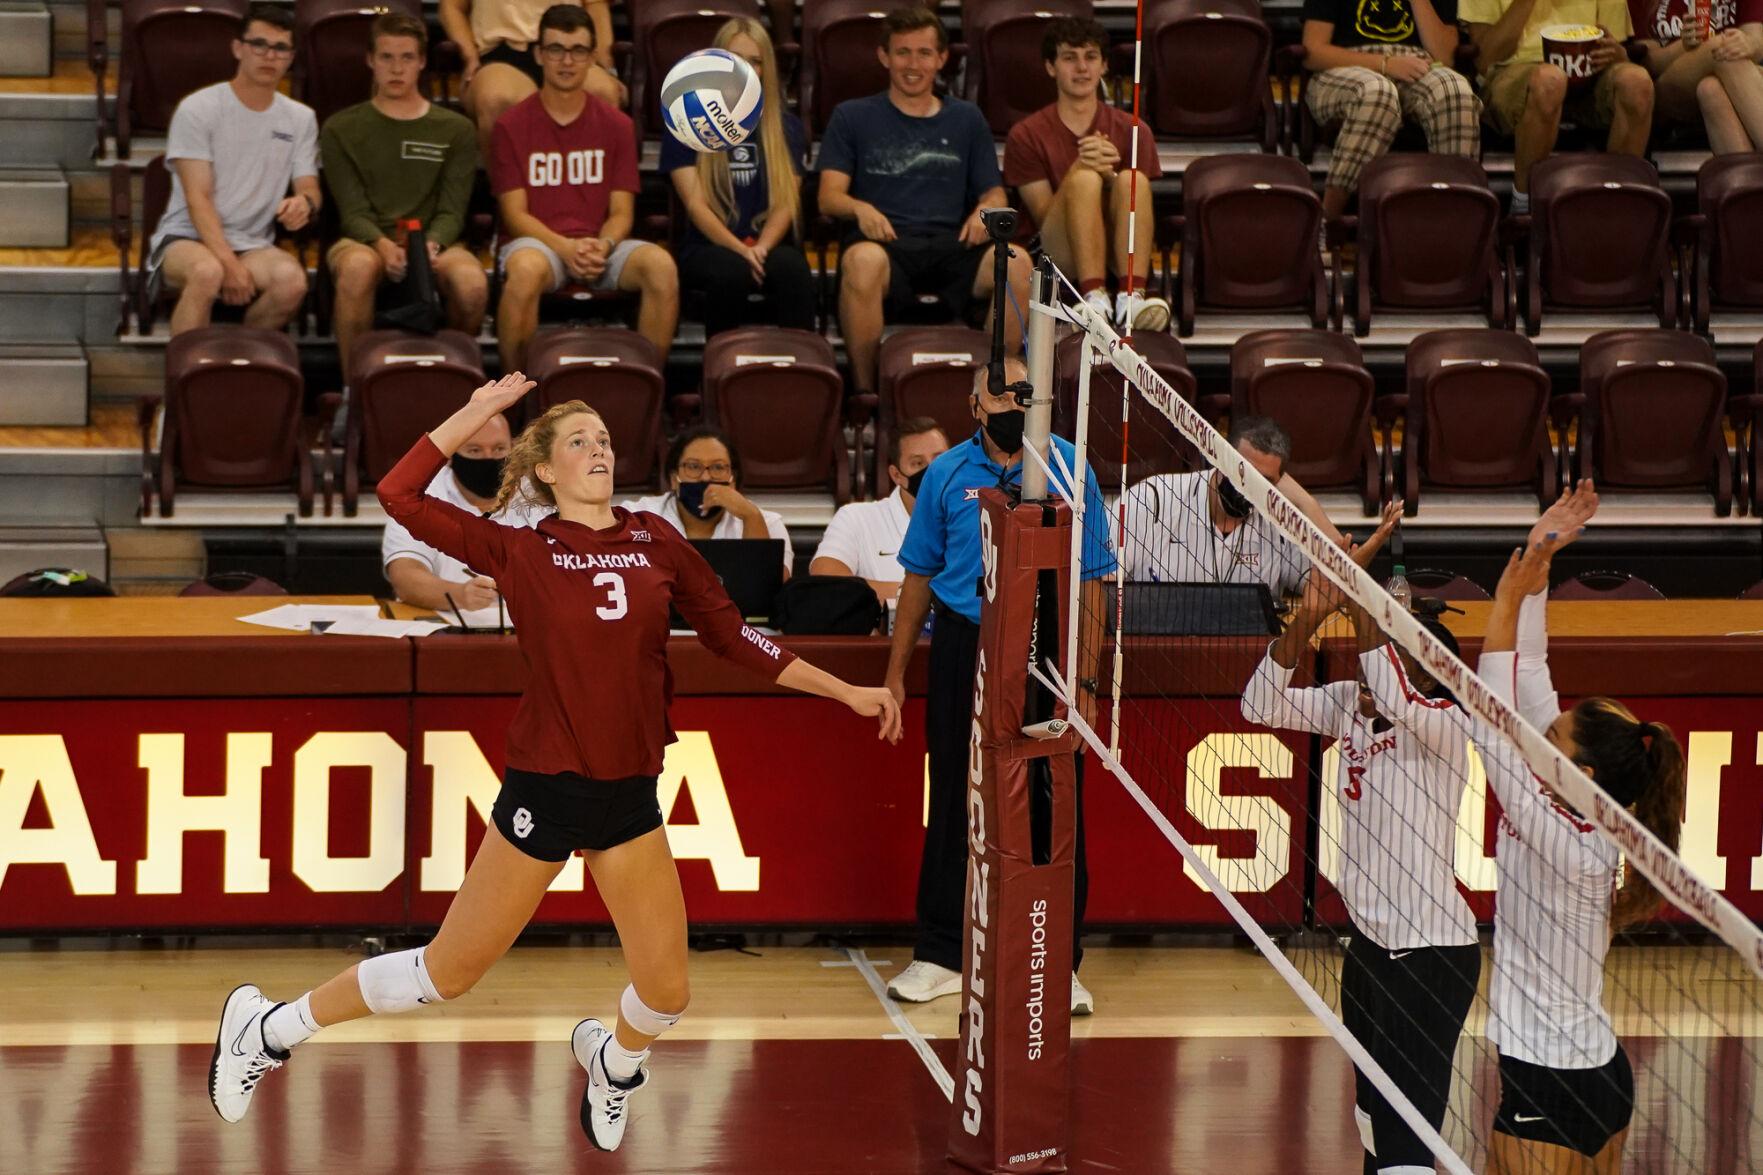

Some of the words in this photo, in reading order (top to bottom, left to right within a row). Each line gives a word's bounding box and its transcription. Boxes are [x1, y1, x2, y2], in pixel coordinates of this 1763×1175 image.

[706, 100, 742, 142] molten
[529, 152, 563, 187] GO
[567, 149, 605, 185] OU
[552, 552, 652, 570] OKLAHOMA
[592, 572, 628, 620] 3
[741, 624, 782, 660] OONER
[1344, 765, 1367, 801] 5
[512, 807, 535, 838] OU
[1028, 899, 1047, 971] sports
[1026, 973, 1044, 1061] imports
[1009, 1154, 1026, 1165] (800)
